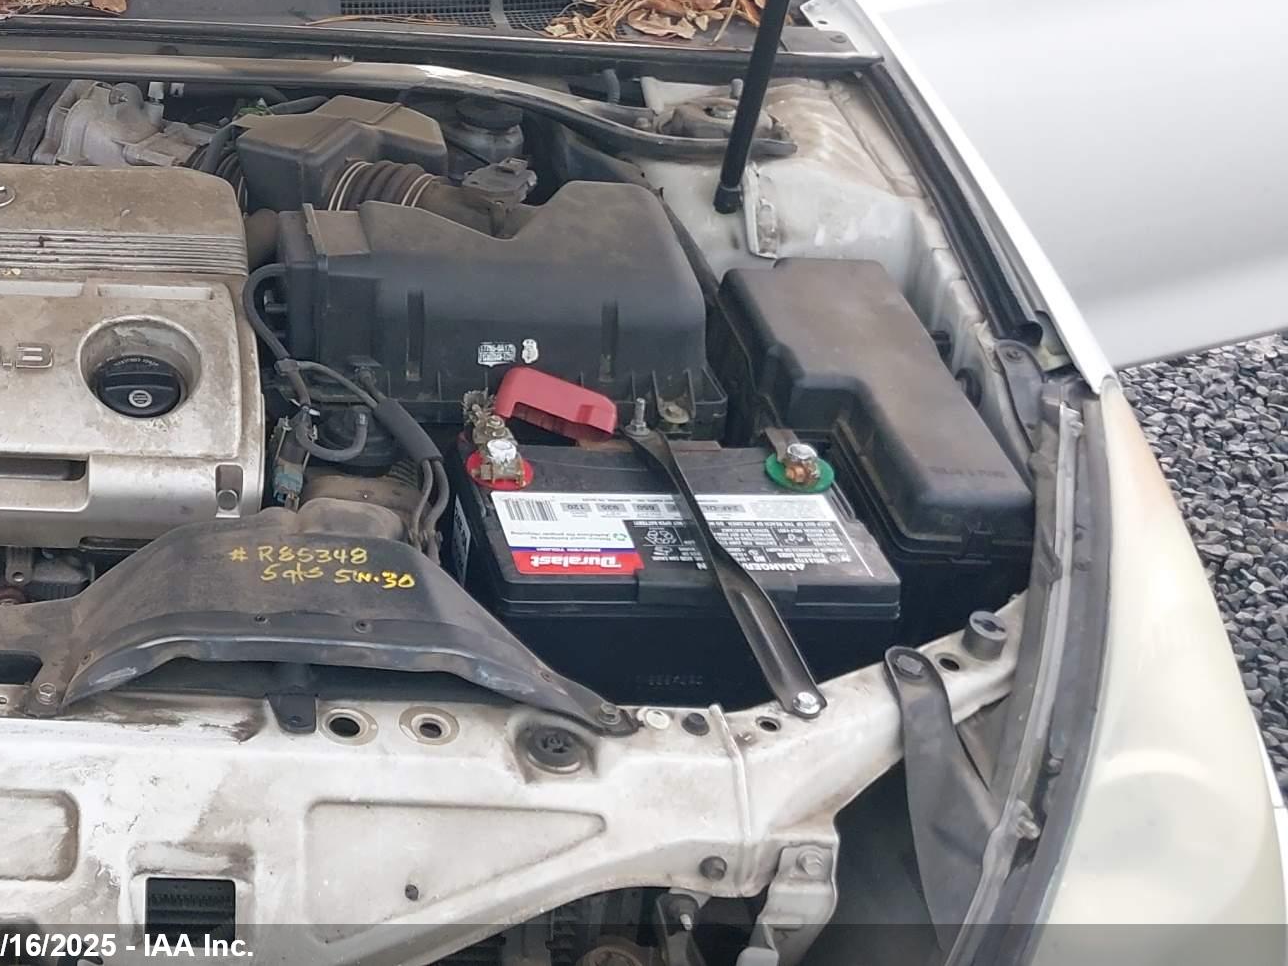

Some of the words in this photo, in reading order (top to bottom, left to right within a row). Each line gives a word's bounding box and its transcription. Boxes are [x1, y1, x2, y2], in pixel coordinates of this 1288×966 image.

[229, 546, 248, 562] #
[257, 545, 368, 564] R85348
[530, 556, 622, 568] Duralast
